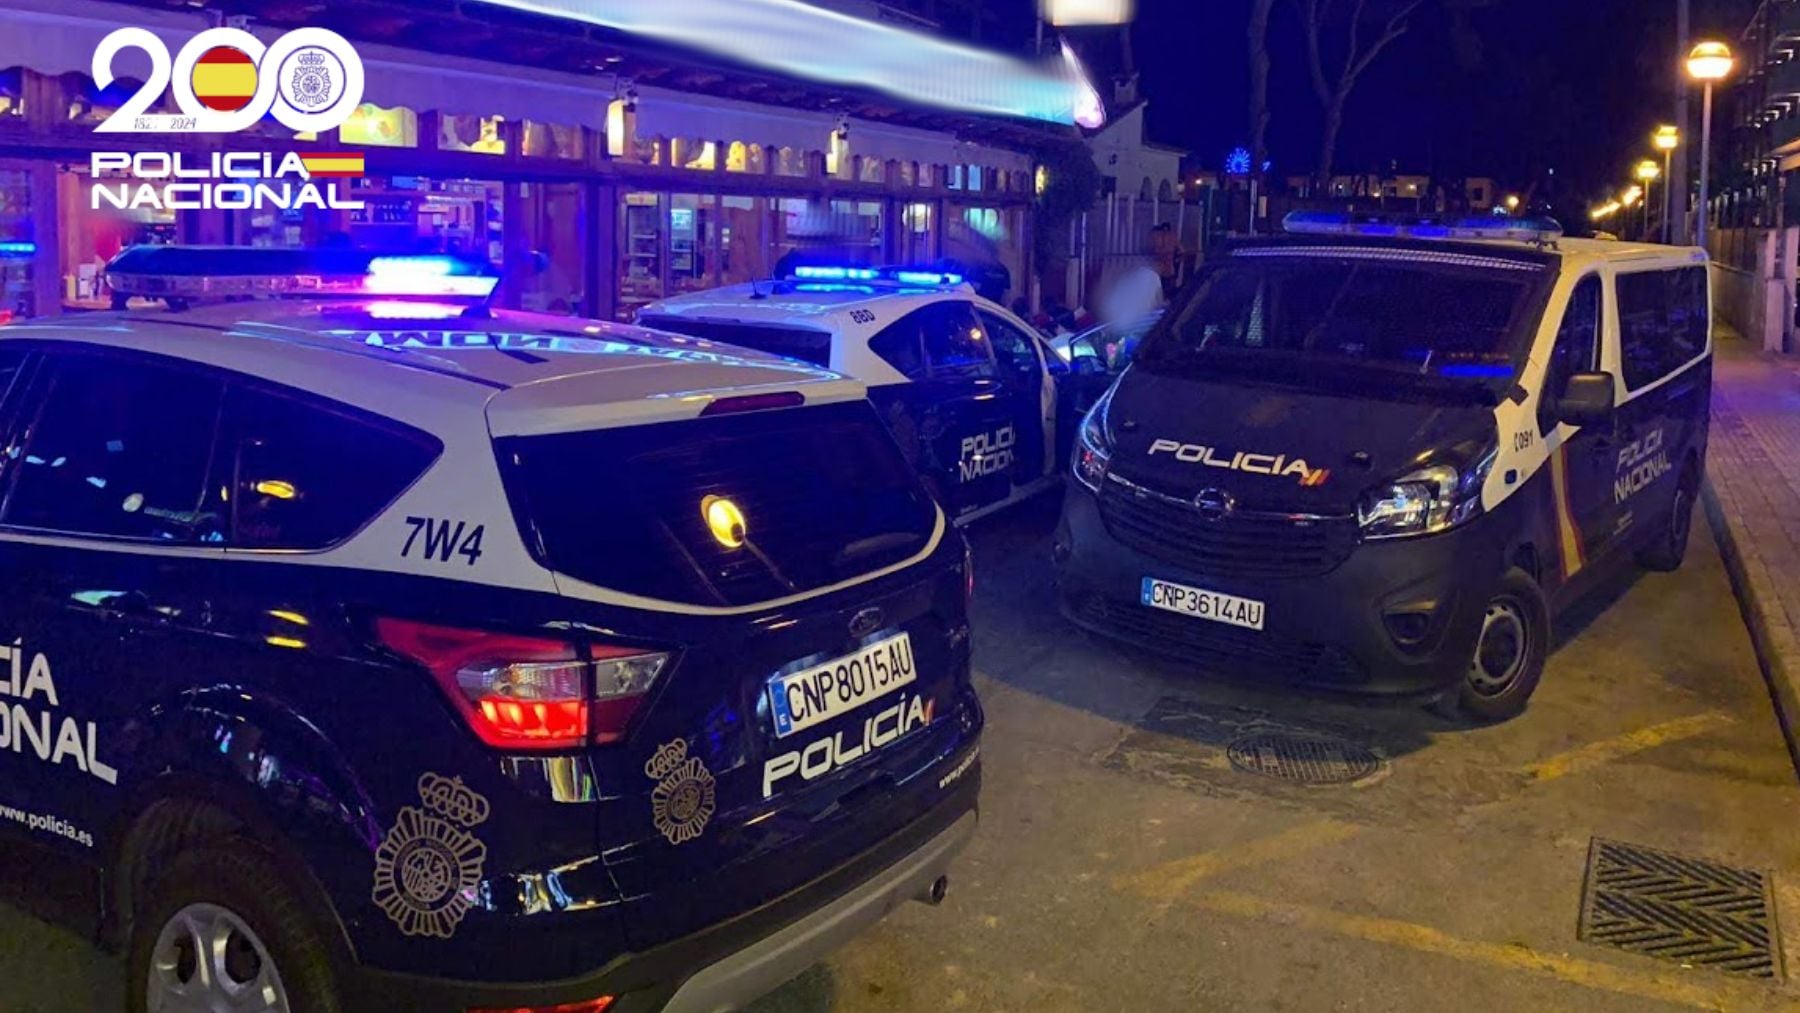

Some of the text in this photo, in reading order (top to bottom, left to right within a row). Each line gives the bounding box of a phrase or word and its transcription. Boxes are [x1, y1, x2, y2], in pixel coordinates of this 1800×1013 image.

[401, 516, 485, 566] 7W4
[779, 638, 912, 726] E CNP8015AU
